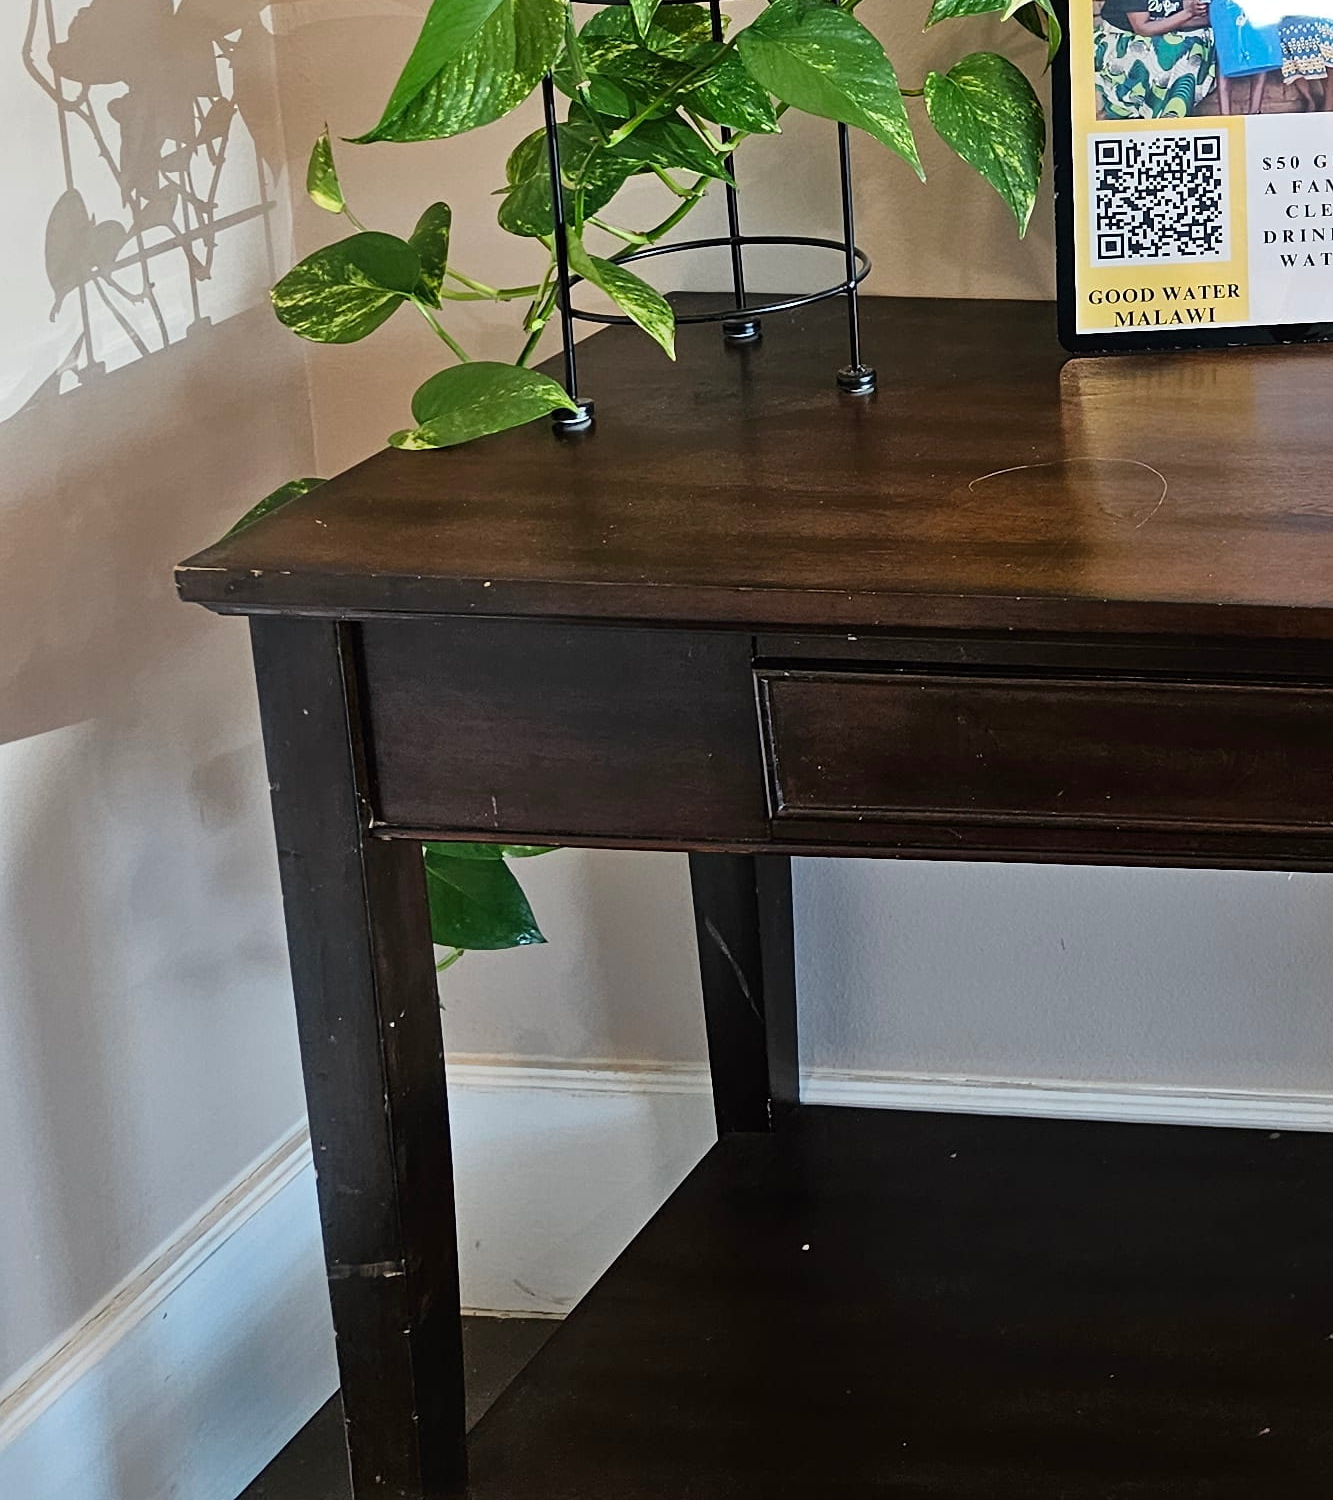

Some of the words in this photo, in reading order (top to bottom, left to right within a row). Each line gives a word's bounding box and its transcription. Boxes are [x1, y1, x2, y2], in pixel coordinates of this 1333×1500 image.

[1262, 155, 1300, 171] $50
[1265, 182, 1277, 195] A
[1088, 286, 1155, 305] GOOD
[1162, 283, 1241, 302] WATER
[1114, 307, 1216, 328] MALAWI
